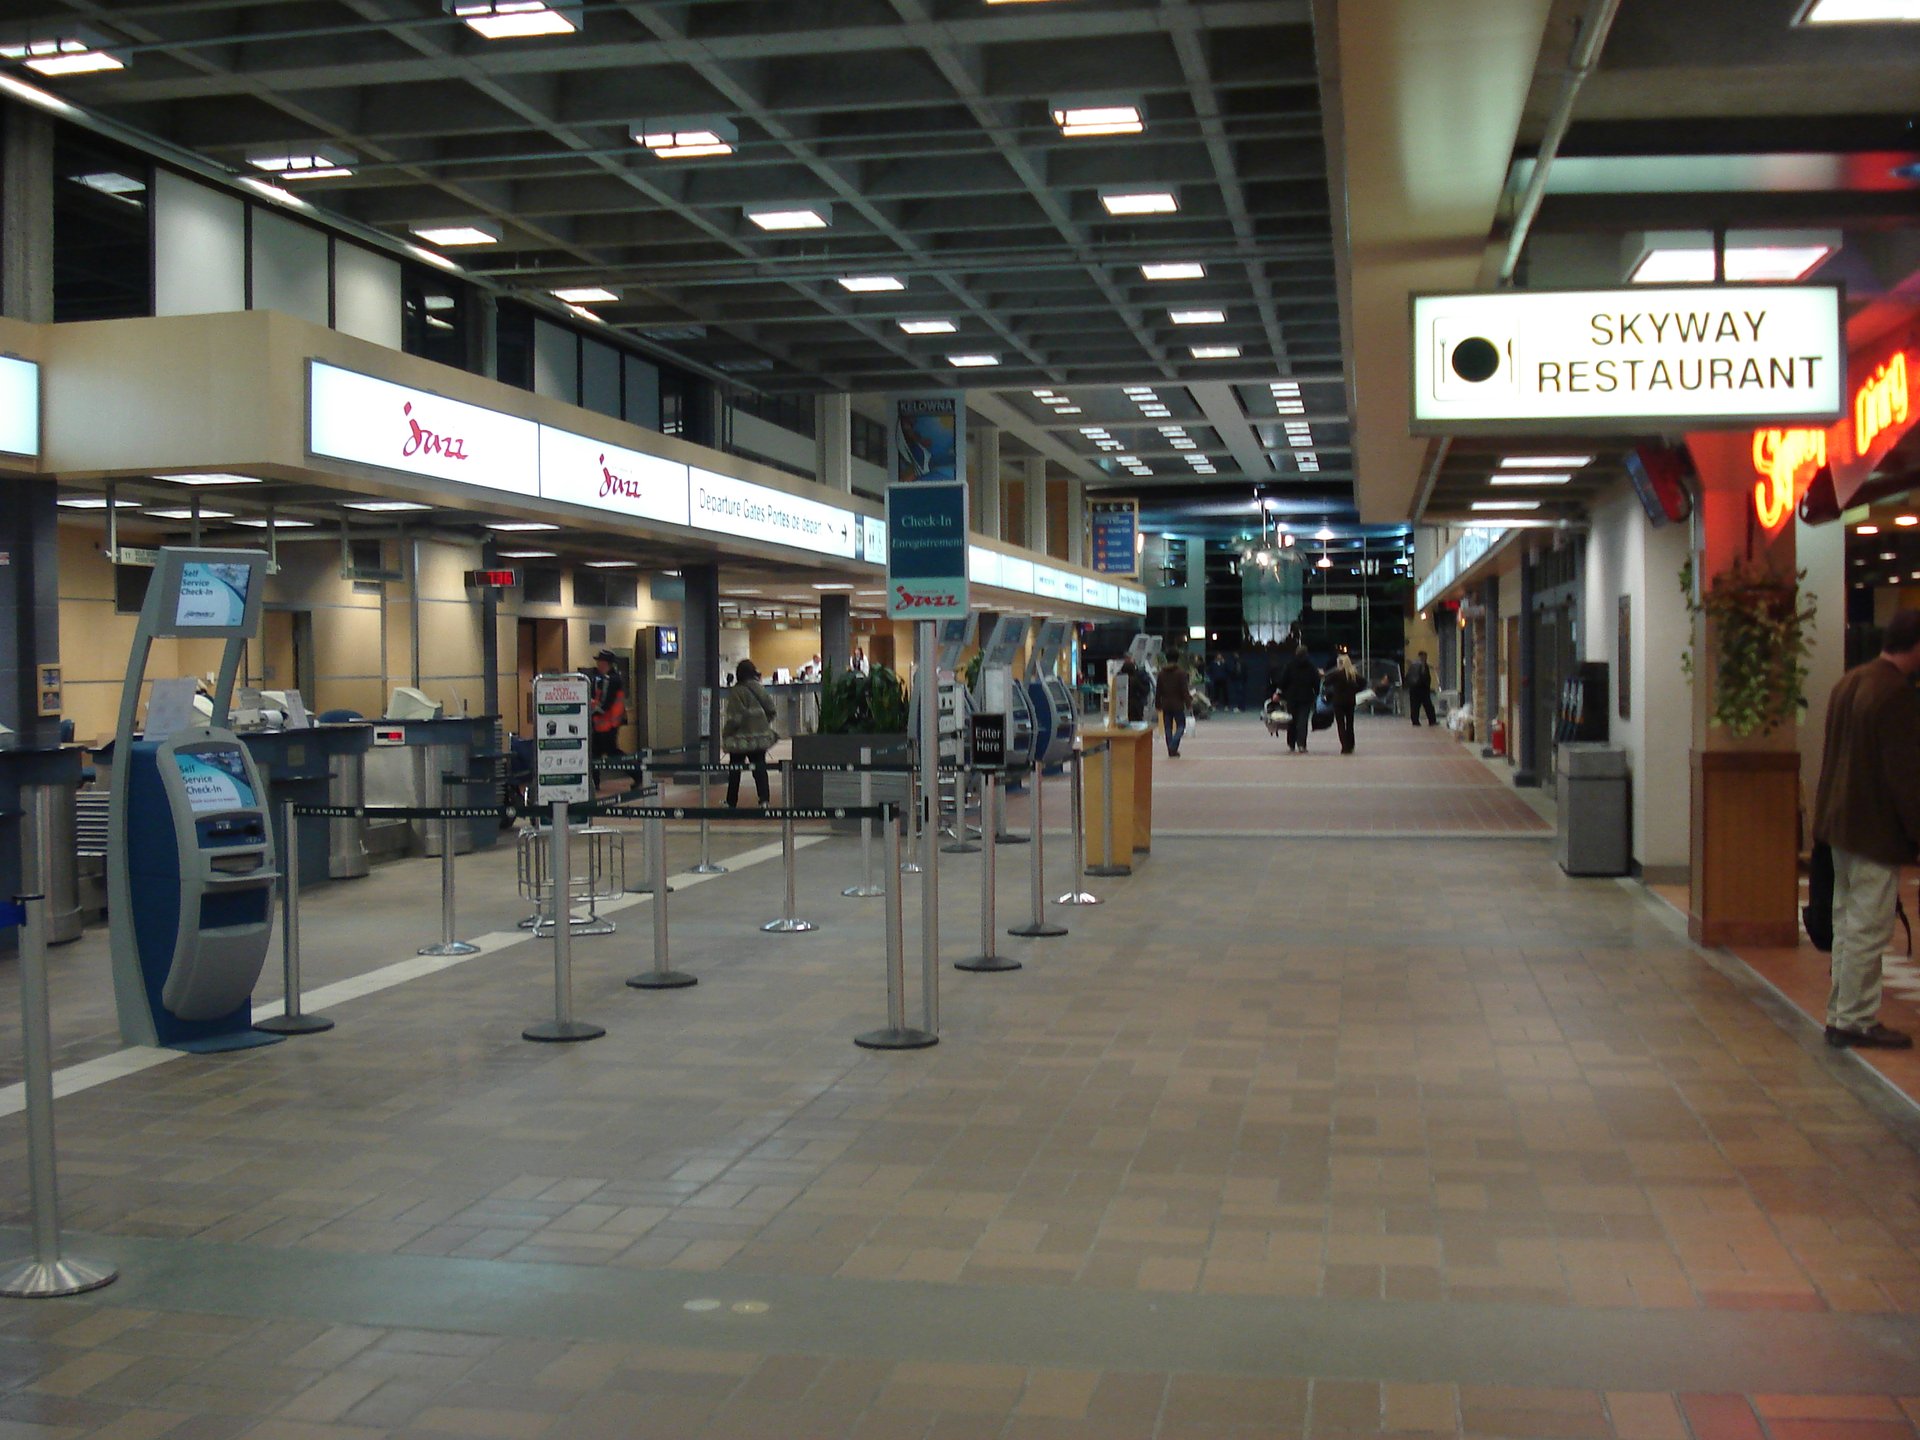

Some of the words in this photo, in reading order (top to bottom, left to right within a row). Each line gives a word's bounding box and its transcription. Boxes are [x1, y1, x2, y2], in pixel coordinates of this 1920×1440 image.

[1591, 310, 1766, 346] SKYWAY
[1538, 356, 1823, 393] RESTAURANT
[900, 401, 953, 412] KELOWNA
[699, 487, 741, 517] Departure
[743, 498, 765, 523] Gates
[767, 503, 790, 528] Portes
[901, 514, 952, 528] Check-In
[892, 538, 963, 550] Enregistrement
[183, 569, 199, 578] Self
[182, 579, 210, 587] Service
[181, 587, 214, 596] Check-In
[975, 727, 1001, 738] Enter
[976, 740, 1000, 753] Here
[178, 764, 195, 774] Self
[182, 776, 213, 785] Service
[186, 786, 222, 795] Check-In
[786, 810, 827, 818] CANADA
